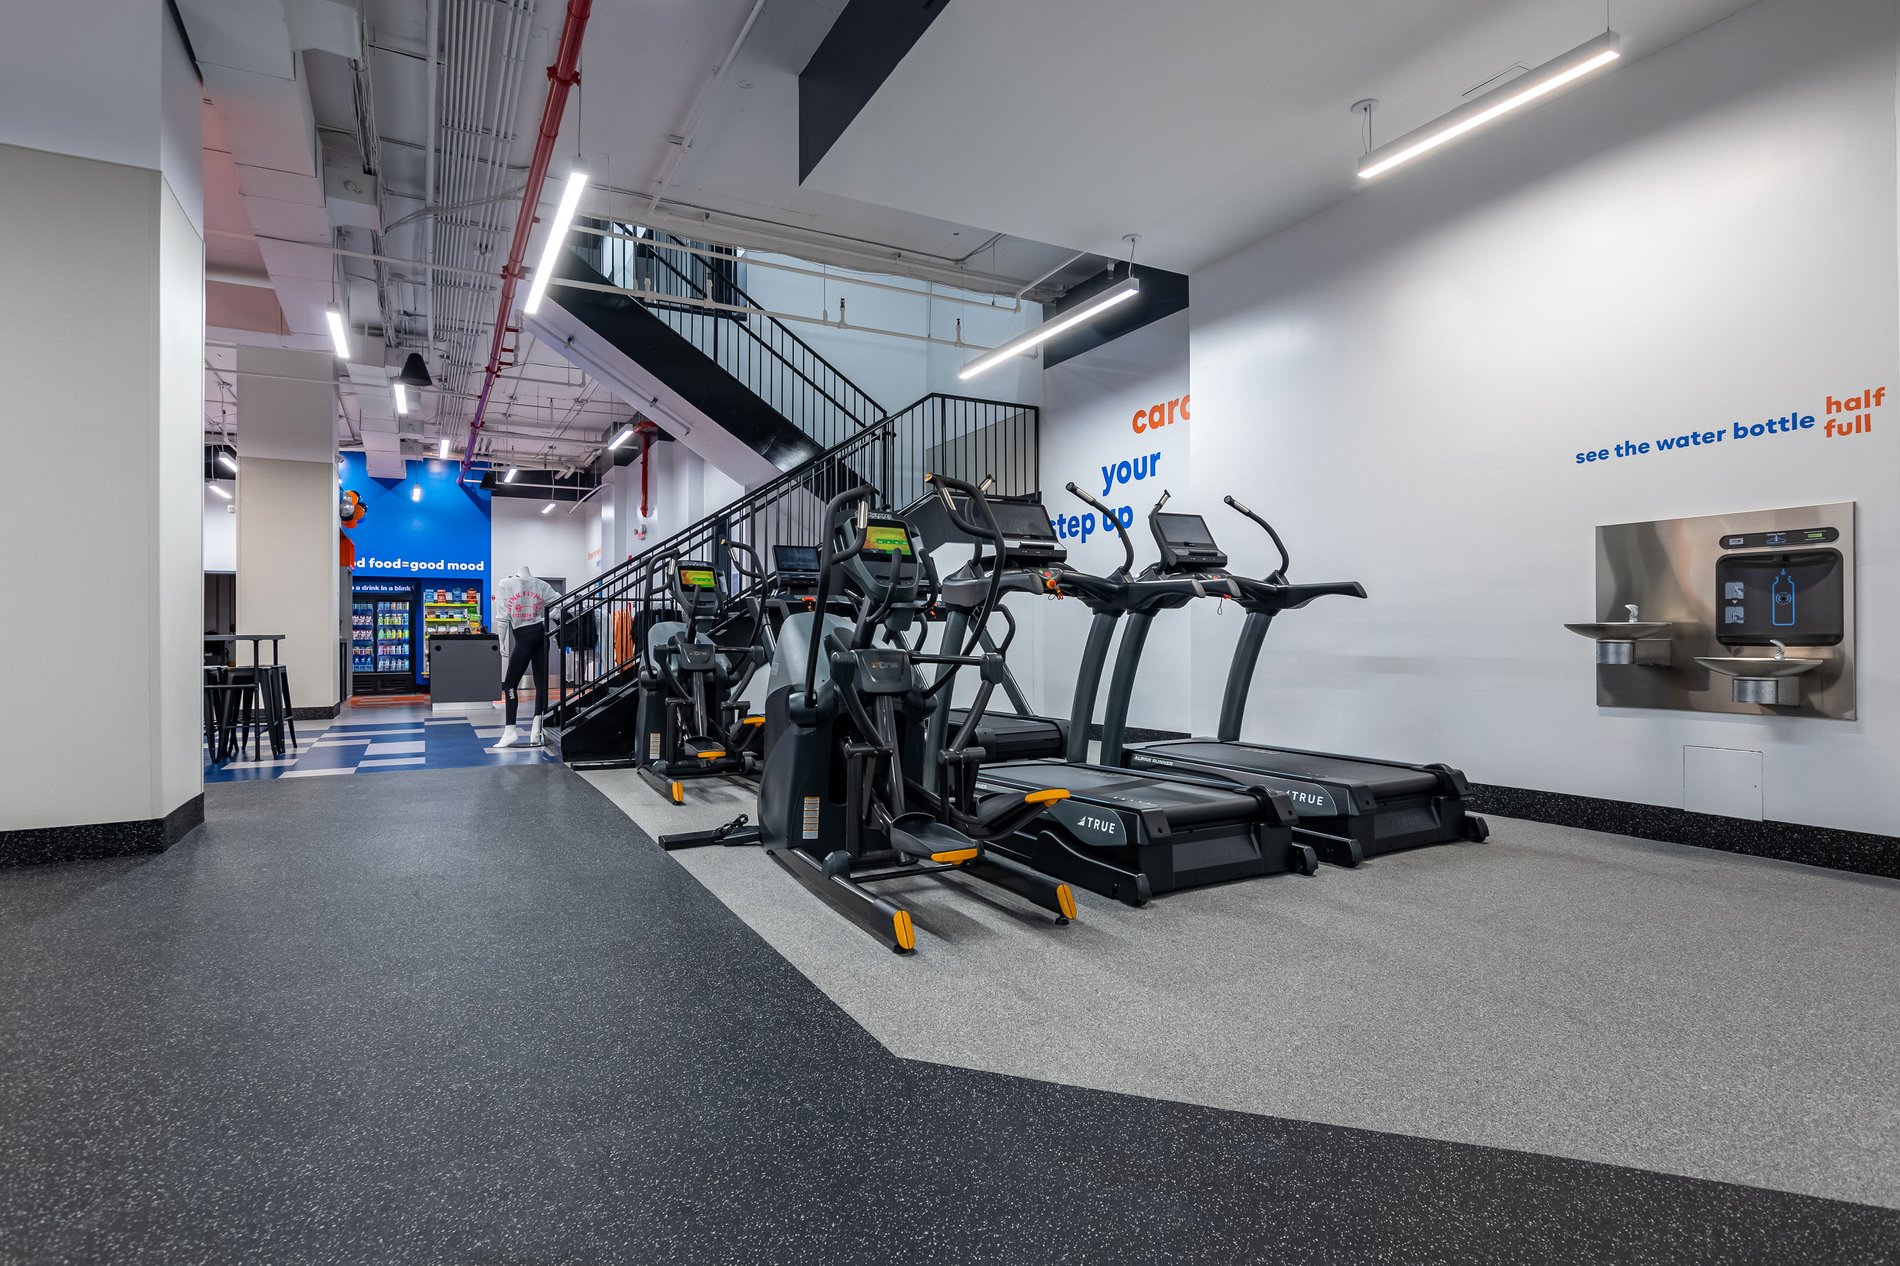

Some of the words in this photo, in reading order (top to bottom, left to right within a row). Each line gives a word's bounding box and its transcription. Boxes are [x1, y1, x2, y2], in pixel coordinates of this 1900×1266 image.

[1825, 386, 1886, 415] half
[1574, 448, 1610, 465] see
[1614, 440, 1651, 459] the
[1656, 428, 1727, 453] water
[1733, 411, 1816, 440] bottle
[1823, 413, 1872, 439] full
[1101, 451, 1161, 497] your
[1102, 505, 1134, 539] up
[447, 560, 485, 571] mood
[1152, 758, 1174, 767] RUNNER
[1291, 790, 1324, 806] TRUE
[1086, 816, 1116, 834] TRUE
